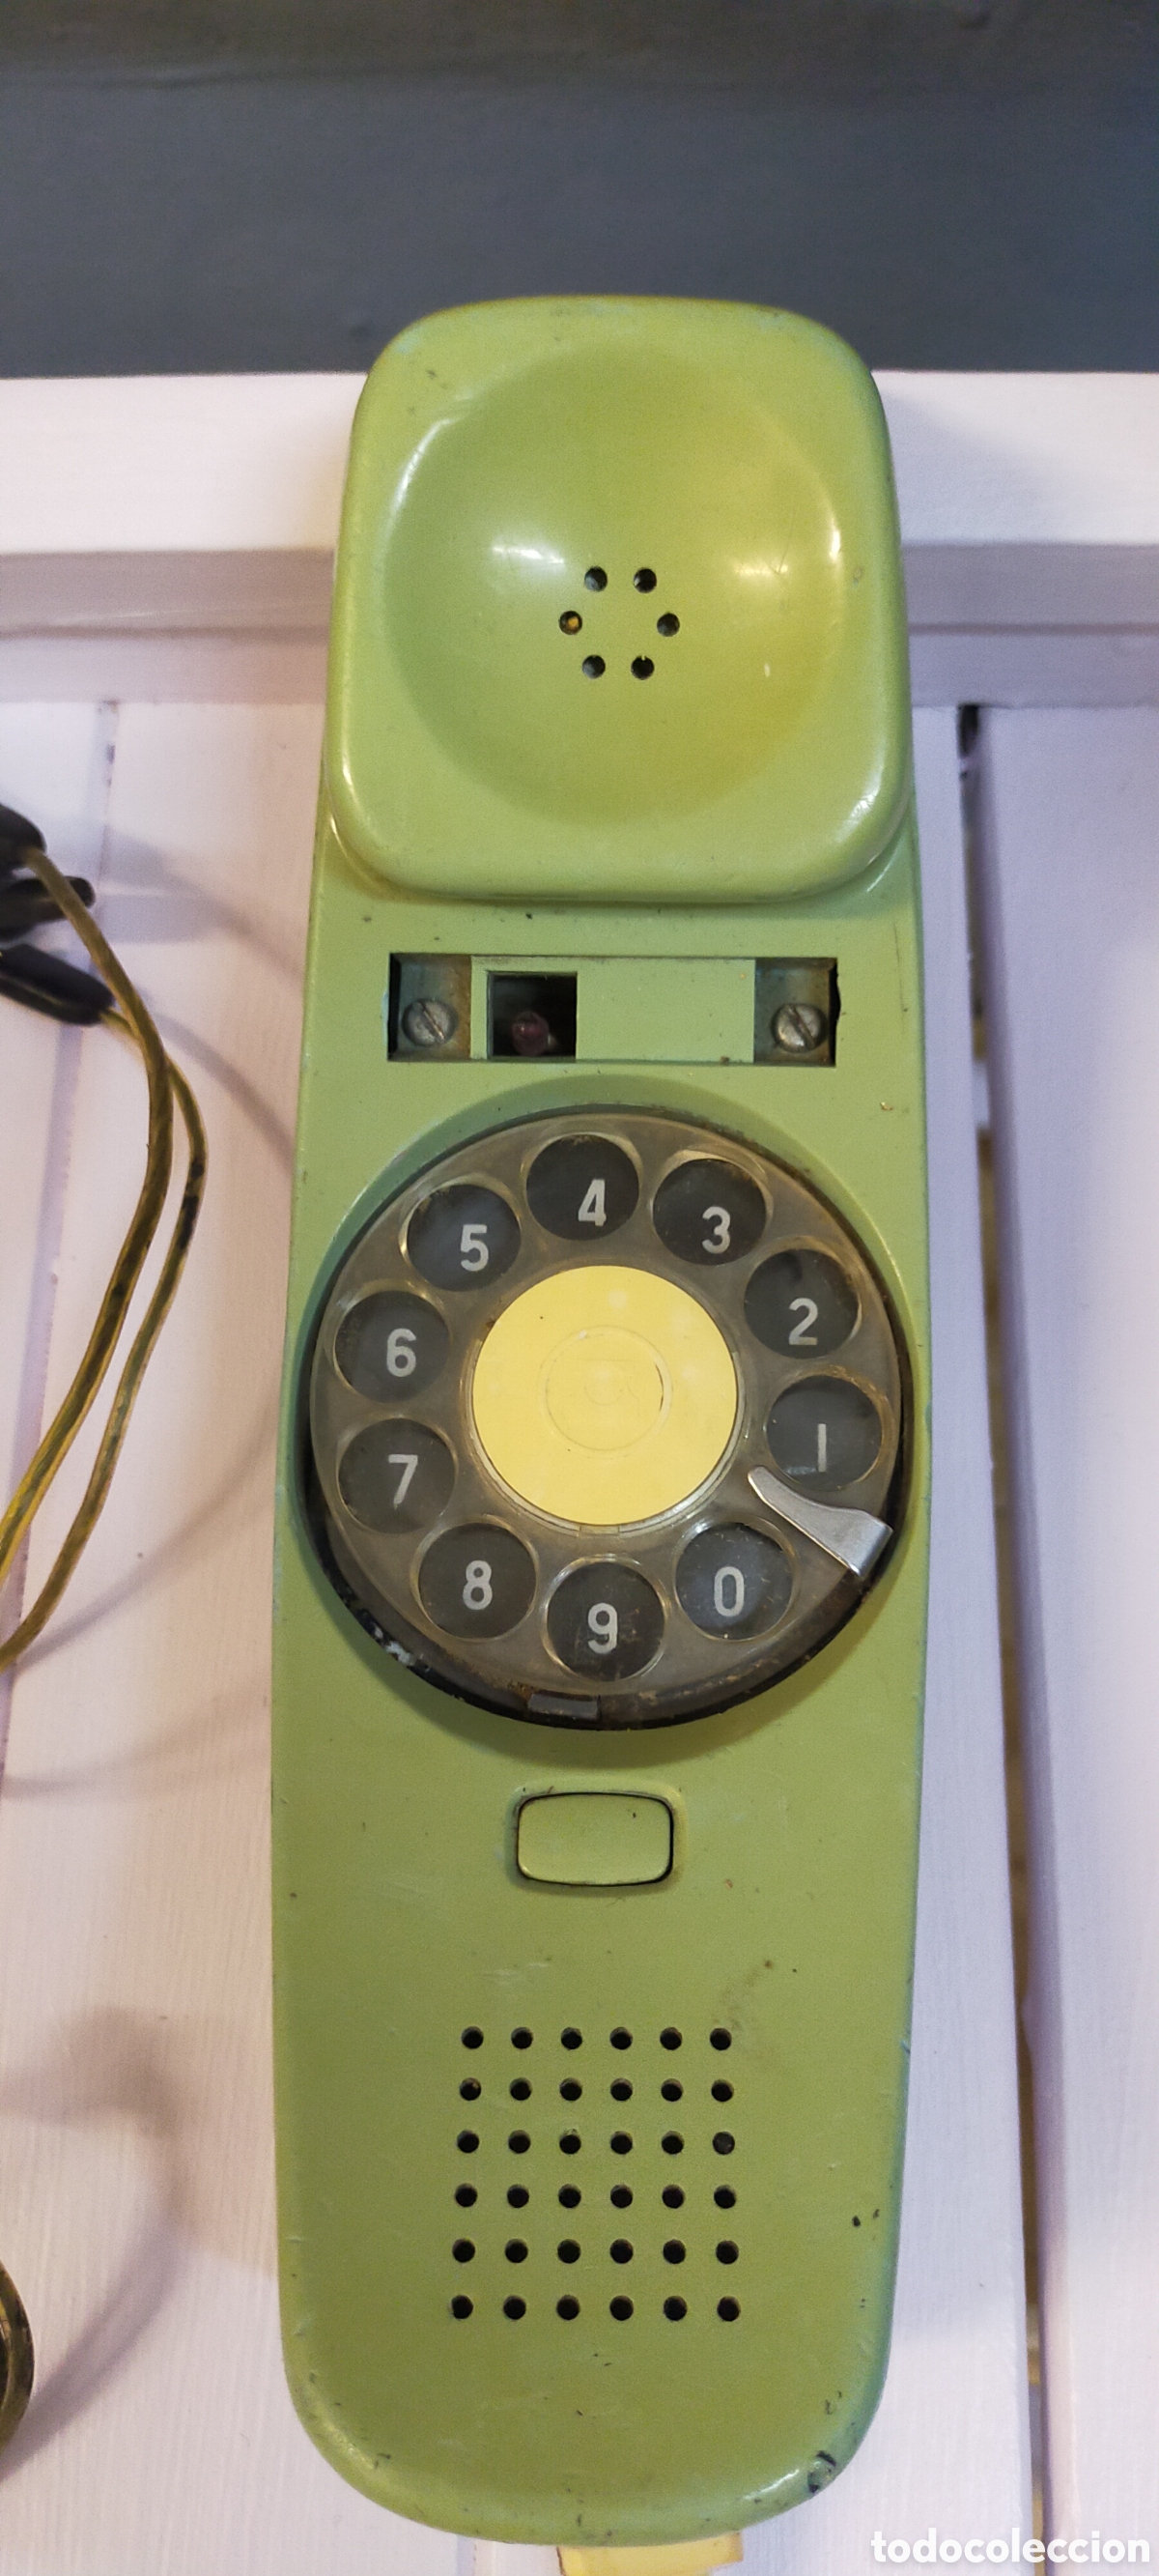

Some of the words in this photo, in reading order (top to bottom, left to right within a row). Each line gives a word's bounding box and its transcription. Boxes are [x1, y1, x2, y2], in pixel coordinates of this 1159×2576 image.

[578, 1178, 608, 1227] 4
[459, 1223, 490, 1273] 5
[700, 1206, 732, 1254] 3
[787, 1298, 819, 1347] 2
[385, 1328, 417, 1378] 6
[387, 1453, 419, 1508] 7
[461, 1560, 495, 1611] 8
[713, 1565, 747, 1617] 0
[586, 1601, 620, 1654] 9
